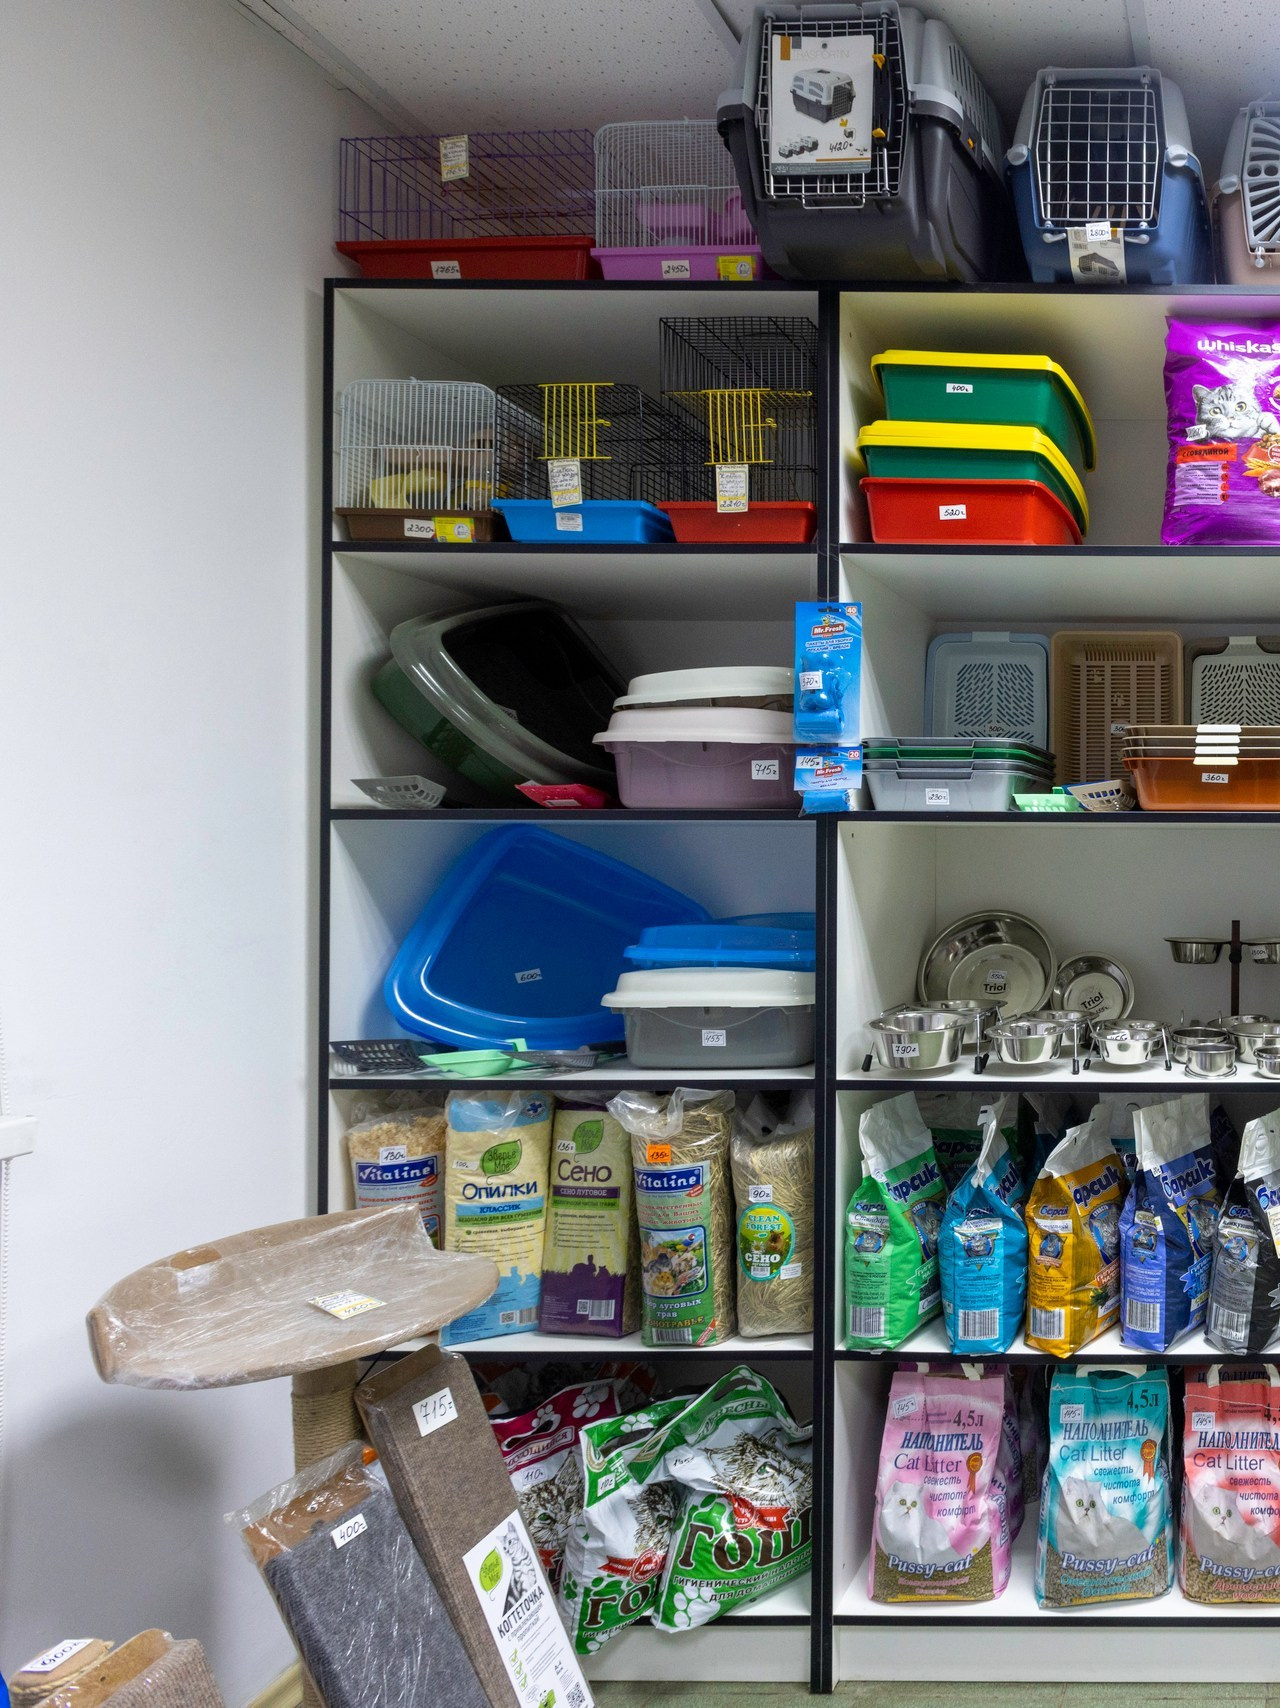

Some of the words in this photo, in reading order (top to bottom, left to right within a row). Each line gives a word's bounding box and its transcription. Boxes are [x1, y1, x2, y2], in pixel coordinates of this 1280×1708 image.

[983, 982, 1007, 992] Triol
[1081, 992, 1104, 1010] Triol
[359, 1165, 431, 1181] Vitaline
[557, 1158, 613, 1183] Сено
[462, 1181, 538, 1200] Опилки
[560, 1188, 578, 1196] СЕНО
[578, 1188, 608, 1197] ЛУГОВОЕ
[479, 1203, 521, 1214] КЛАССИК
[746, 1223, 783, 1231] FOREST
[748, 1215, 780, 1223] CLEAN
[745, 1253, 781, 1264] СЕНО
[659, 1299, 702, 1310] луговых
[656, 1311, 678, 1319] трав
[1126, 1388, 1160, 1412] 4,5л
[1062, 1418, 1149, 1442] НАПОЛНИТЕЛЬ
[1059, 1445, 1086, 1462] Cat
[1090, 1444, 1127, 1462] Litter
[894, 1453, 920, 1470] Cat
[924, 1454, 962, 1473] Litter
[1193, 1453, 1222, 1469] Cat
[1226, 1454, 1265, 1471] Litter
[1093, 1466, 1134, 1476] свежесть
[923, 1475, 962, 1486] свежесть
[1103, 1479, 1141, 1491] чистота
[1229, 1476, 1272, 1486] свежесть
[929, 1491, 968, 1502] чистота
[1112, 1489, 1155, 1505] комфорт
[1239, 1491, 1279, 1501] чистота
[887, 1552, 973, 1579] Pussy-cat
[1060, 1544, 1156, 1576] Pussy-cat
[673, 1570, 770, 1589] ГИГИЕНИЧЕСКИЙ
[709, 1588, 736, 1603] ДЛЯ
[738, 1570, 793, 1600] ДОМАШНИХ
[497, 1585, 545, 1639] КОГТЕТОЧКА
